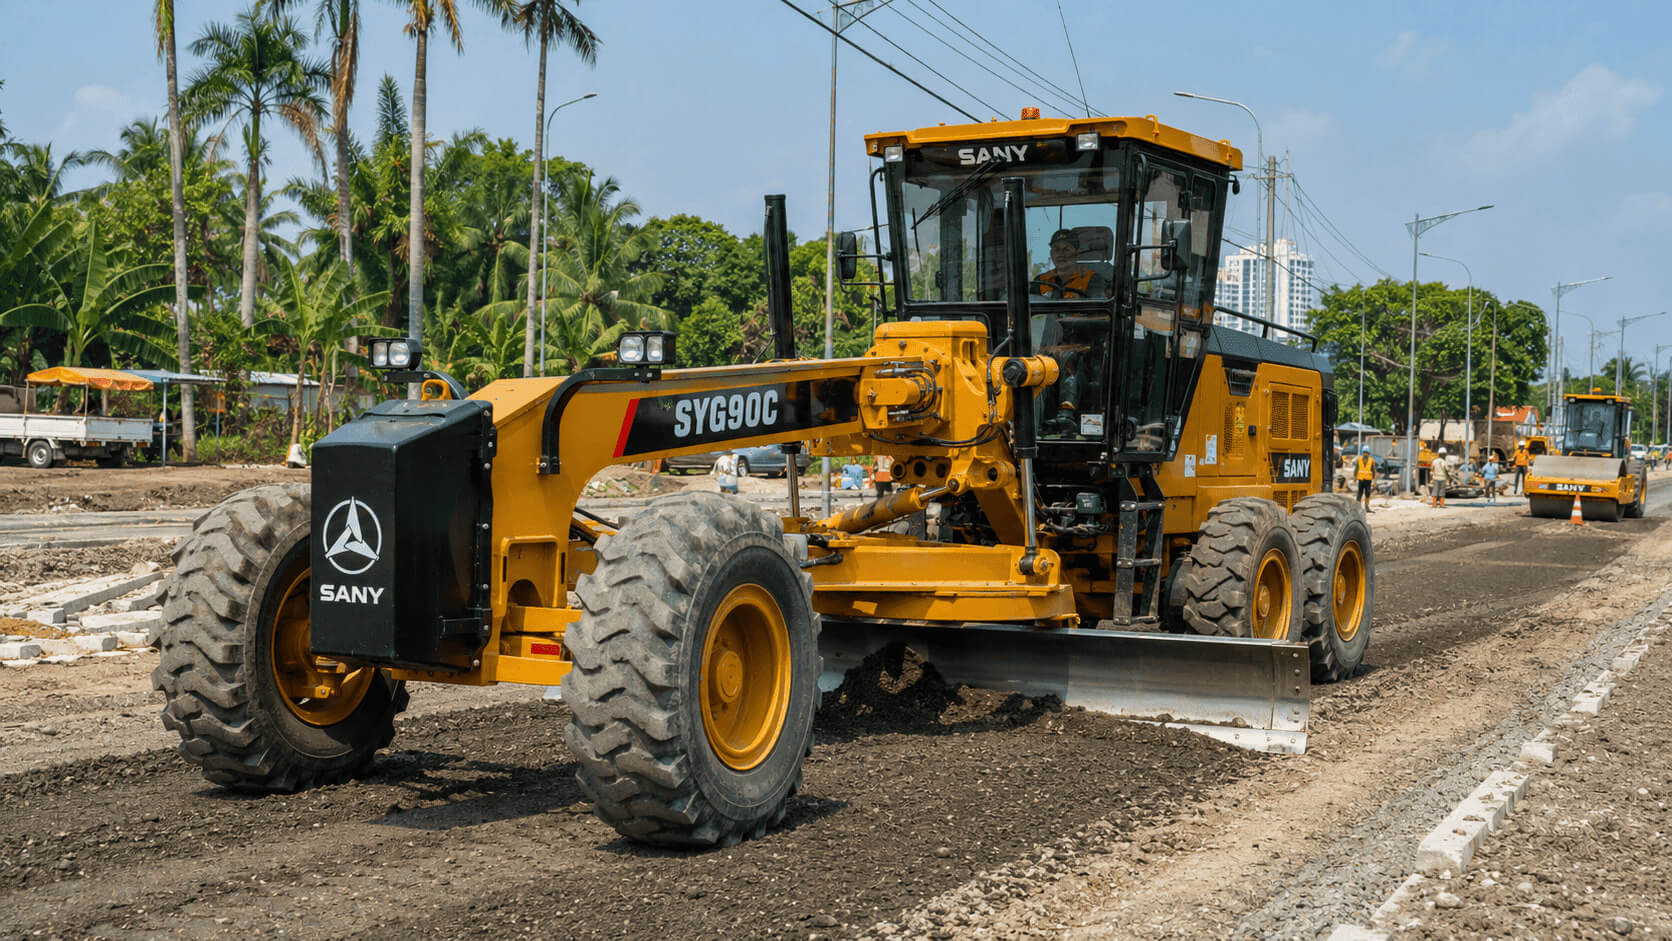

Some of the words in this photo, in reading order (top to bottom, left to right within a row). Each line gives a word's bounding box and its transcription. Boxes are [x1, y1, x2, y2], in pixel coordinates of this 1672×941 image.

[958, 145, 1028, 165] SANY
[674, 390, 778, 437] SYG90C
[1284, 458, 1311, 478] SANY
[320, 584, 384, 605] SANY
